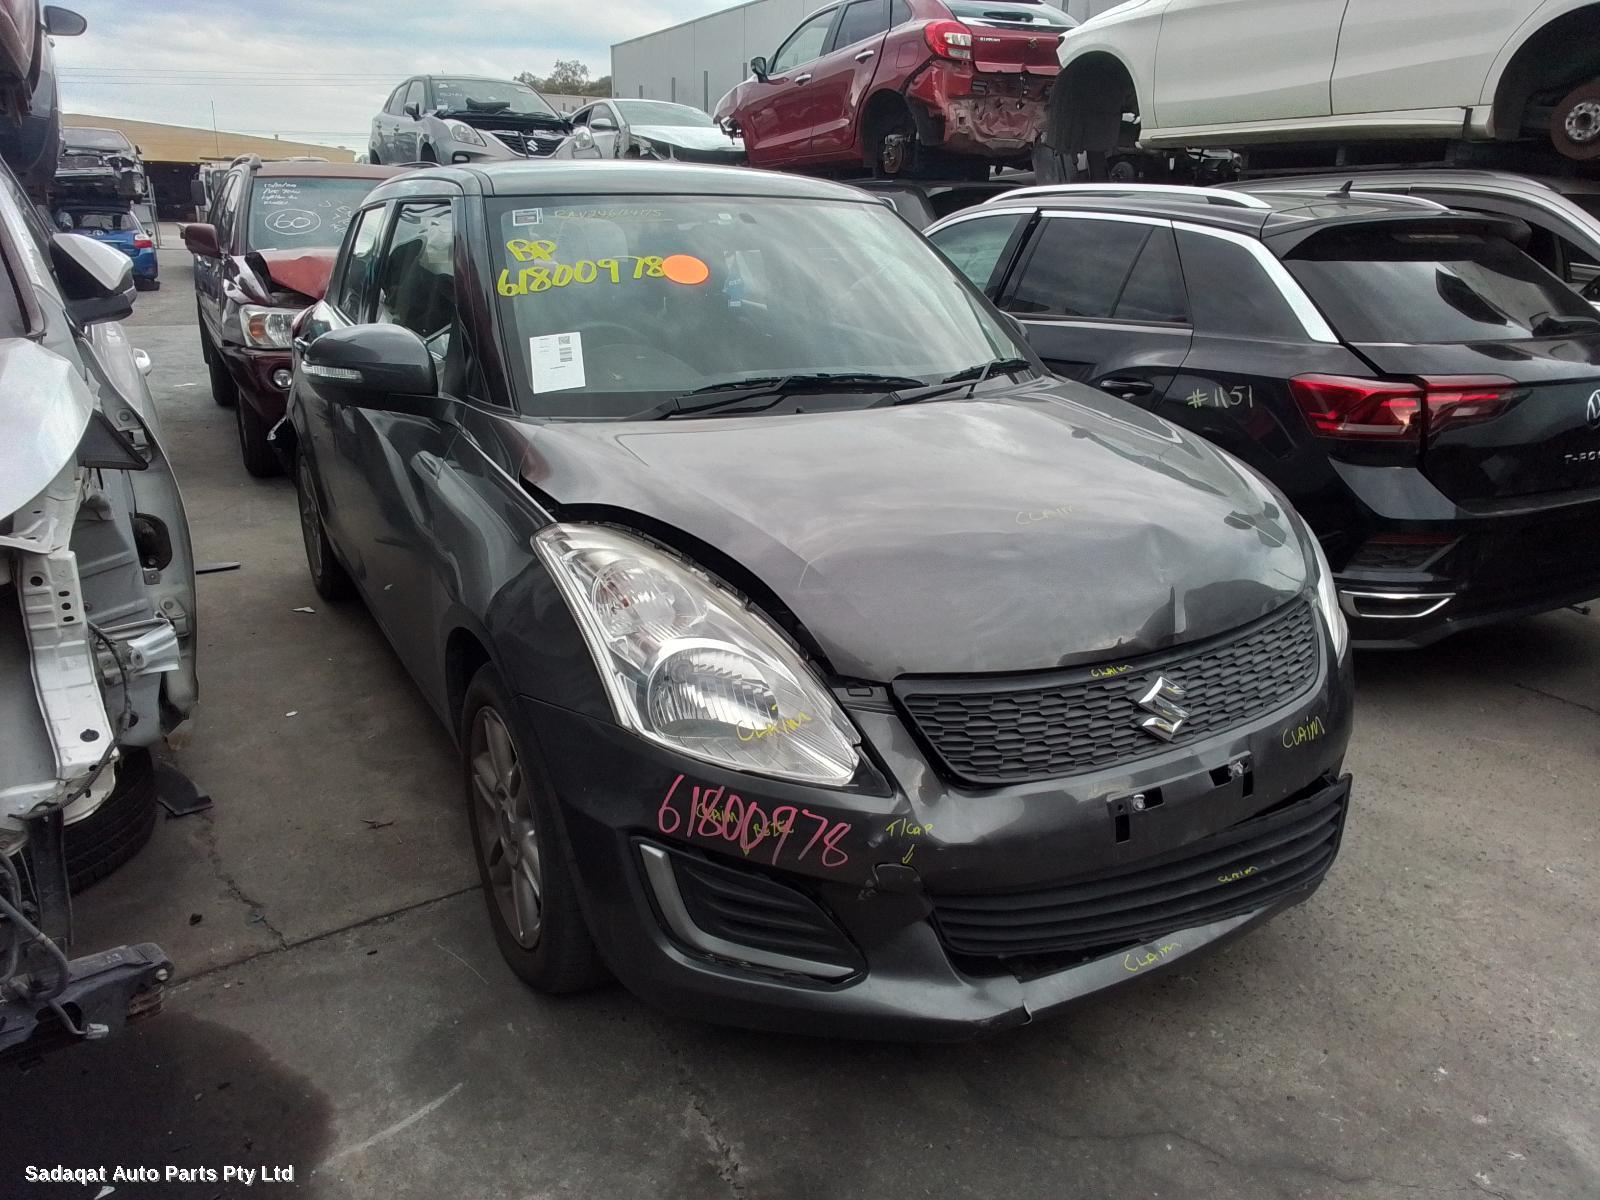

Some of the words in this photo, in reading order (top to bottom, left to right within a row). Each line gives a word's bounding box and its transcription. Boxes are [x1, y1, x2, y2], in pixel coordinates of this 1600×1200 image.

[274, 213, 311, 229] 60
[1185, 384, 1254, 409] #1151
[1564, 450, 1600, 464] T-RO
